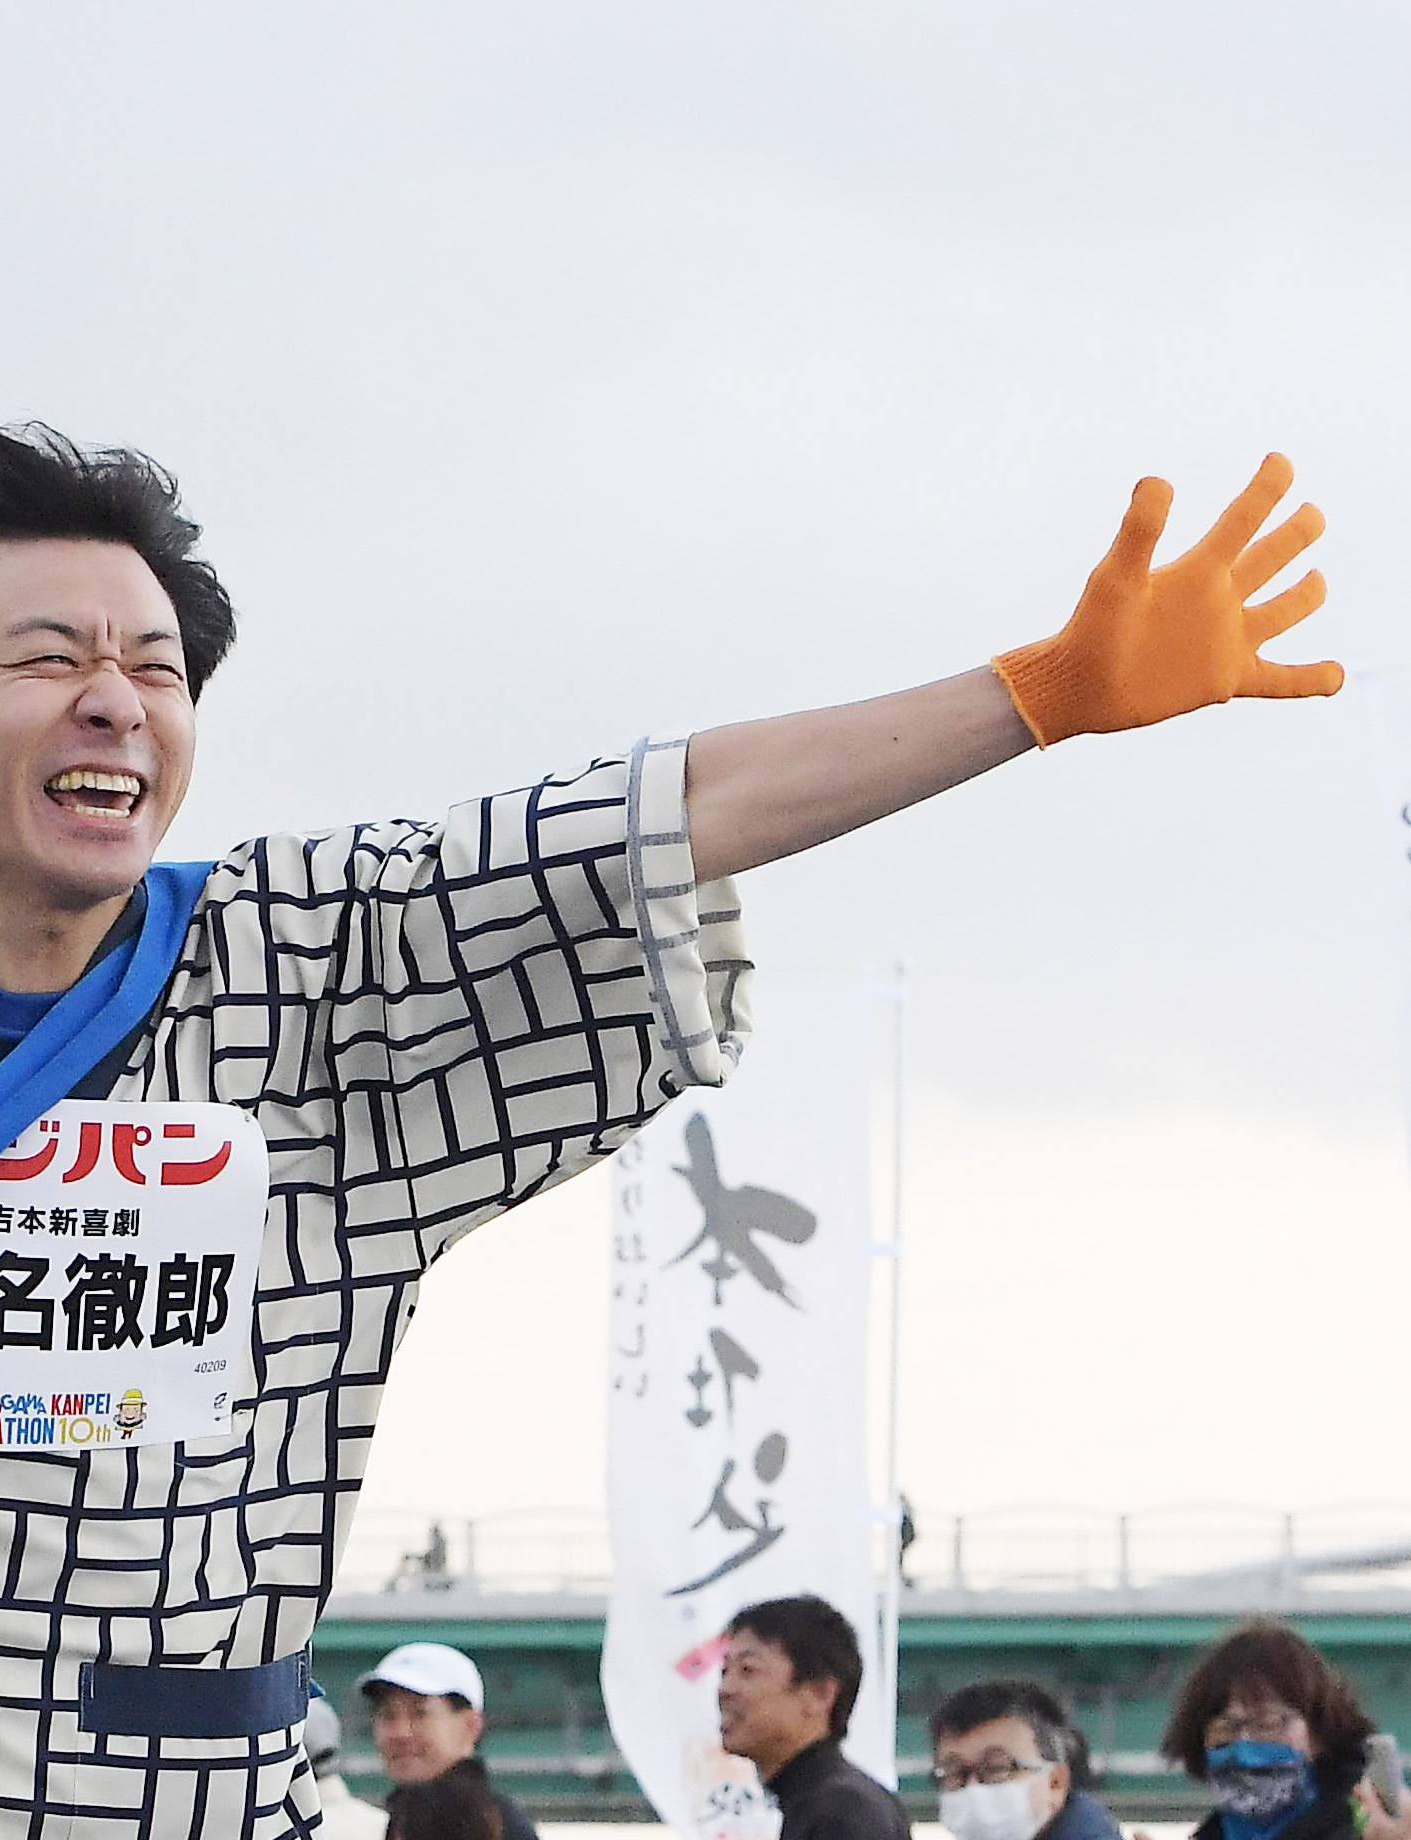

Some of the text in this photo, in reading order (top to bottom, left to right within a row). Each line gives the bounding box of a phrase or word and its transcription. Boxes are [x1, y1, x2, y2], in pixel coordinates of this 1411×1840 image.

[193, 1359, 227, 1373] 40209
[51, 1393, 111, 1416] KANPEI
[58, 1417, 111, 1443] 10th
